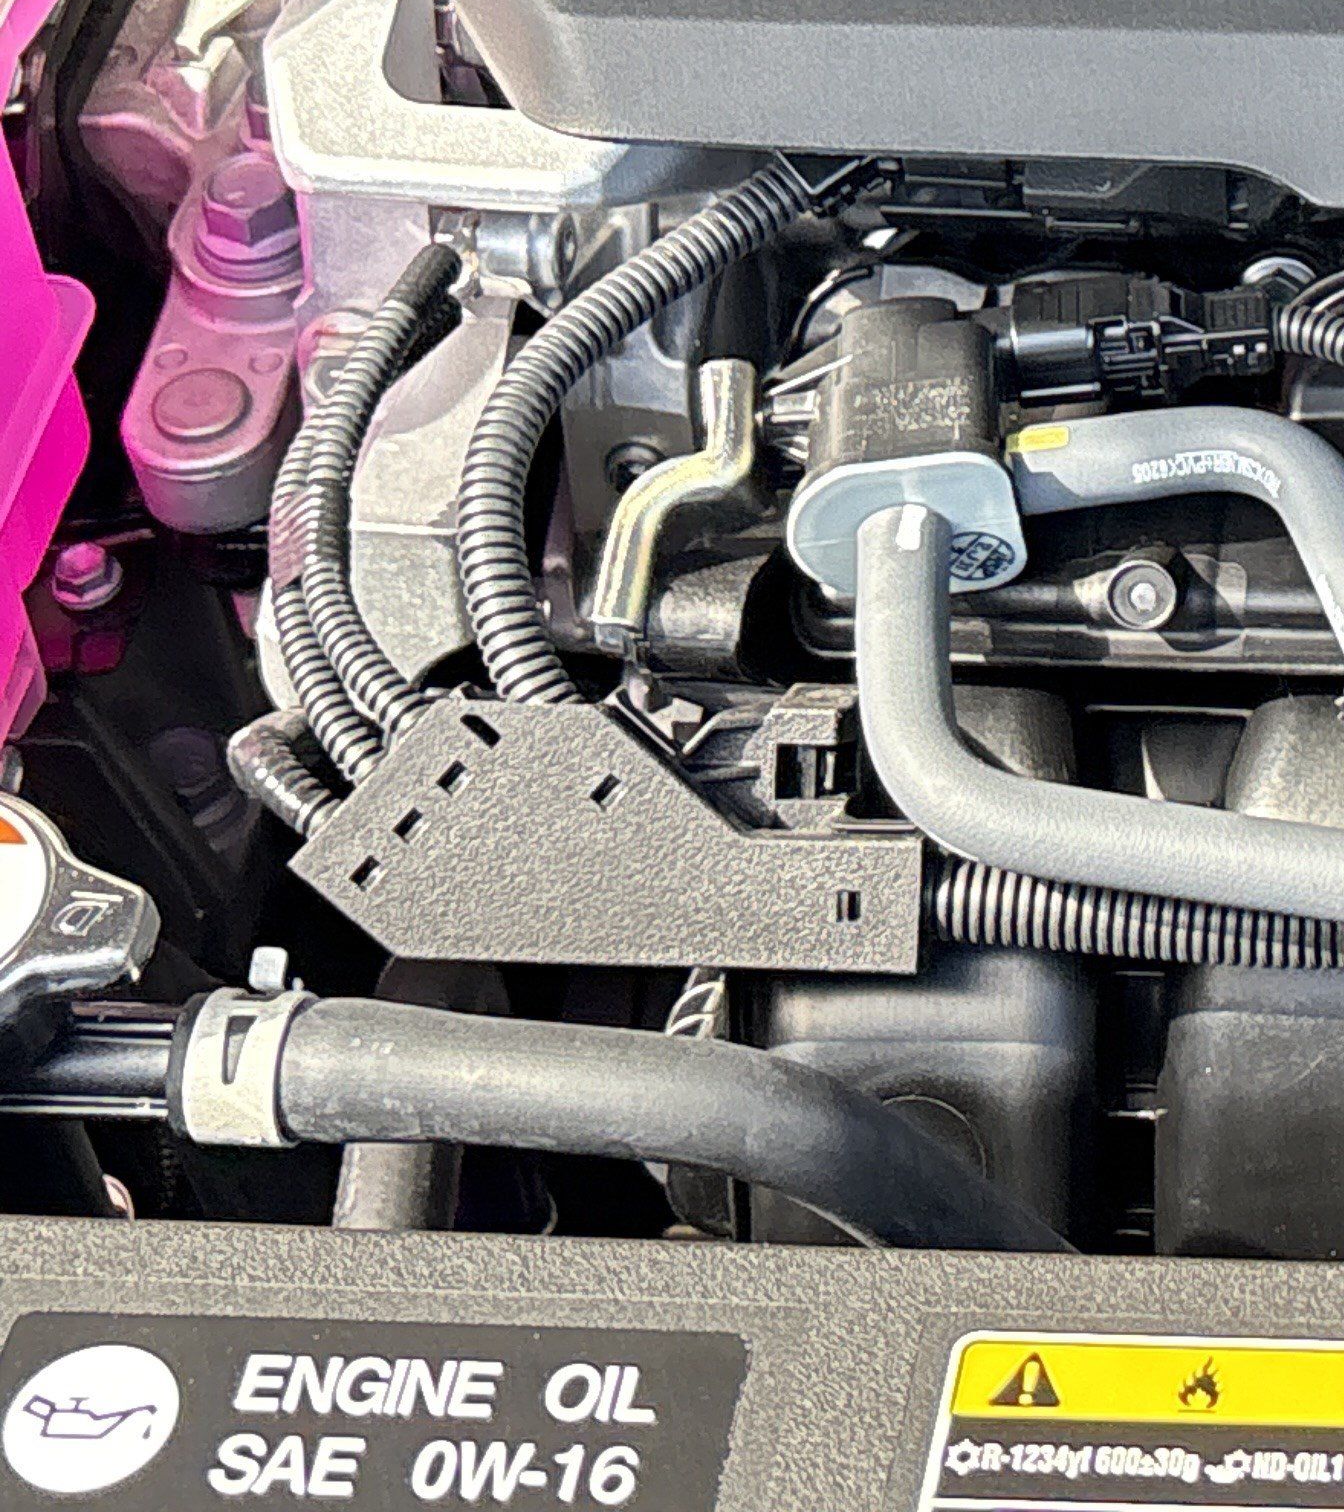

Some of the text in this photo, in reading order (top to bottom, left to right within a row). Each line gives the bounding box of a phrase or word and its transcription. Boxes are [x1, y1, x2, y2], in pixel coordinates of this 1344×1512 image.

[231, 1351, 658, 1425] ENGINE OIL
[206, 1431, 641, 1506] SAE 0W-16
